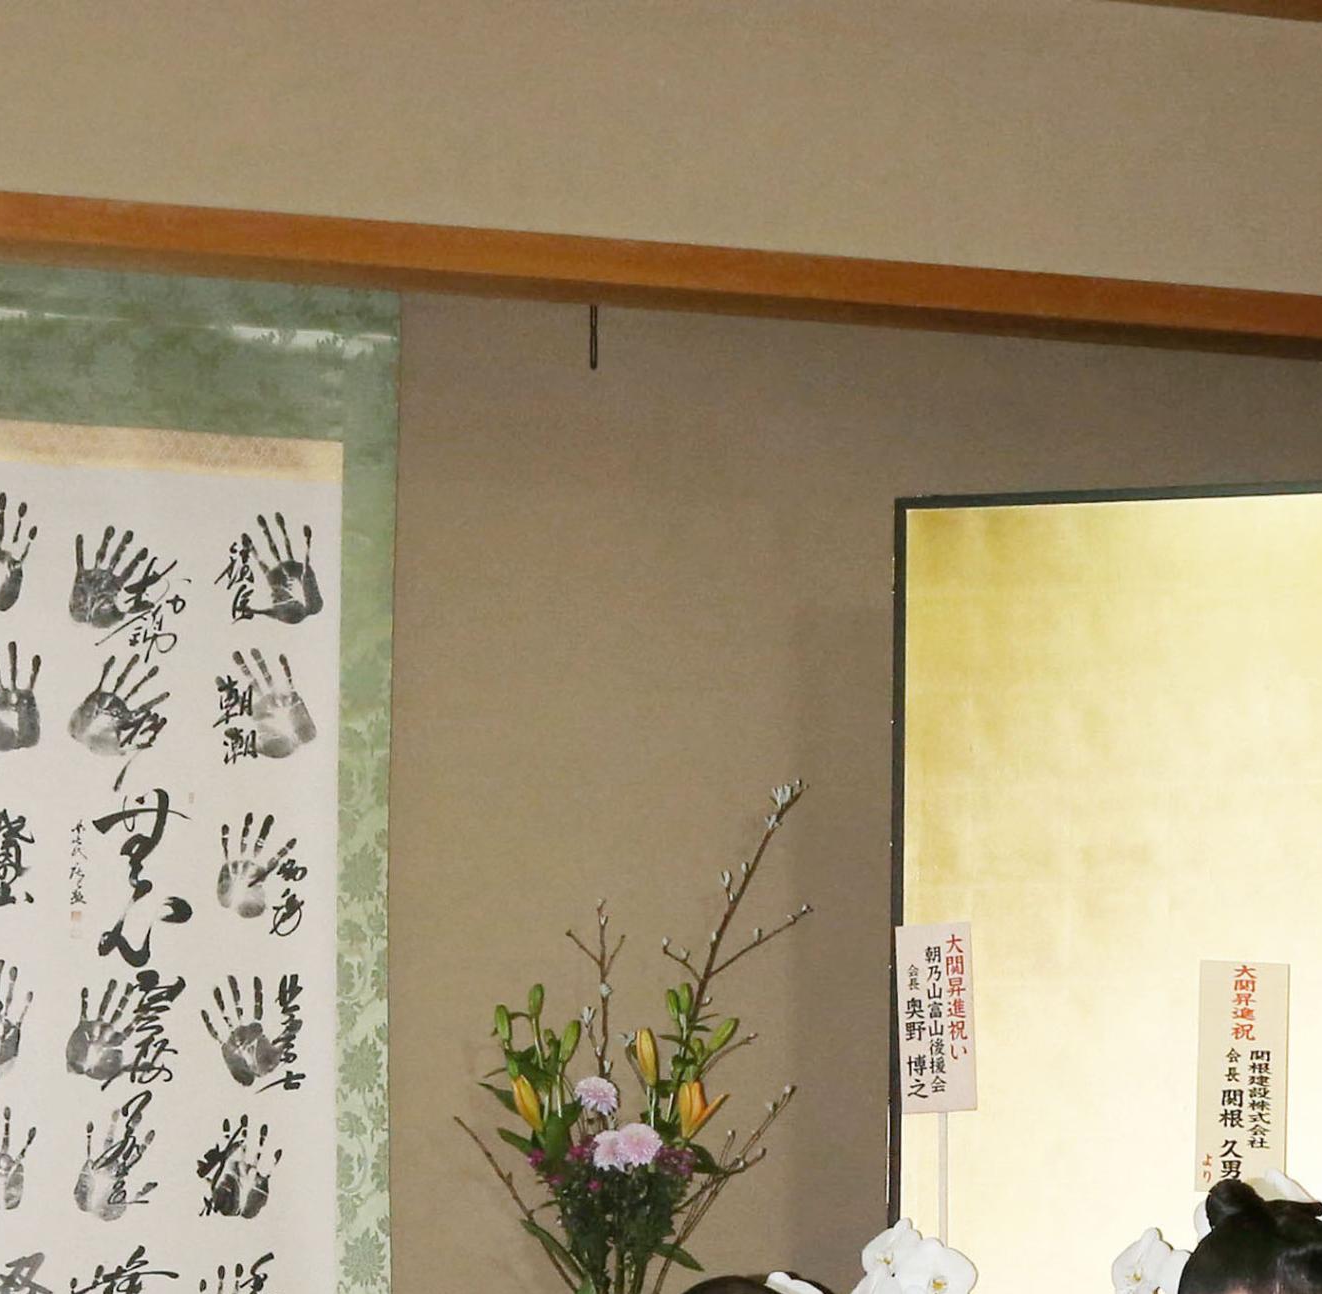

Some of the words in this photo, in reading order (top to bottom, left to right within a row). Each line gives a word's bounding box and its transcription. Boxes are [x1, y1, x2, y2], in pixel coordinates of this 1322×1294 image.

[907, 964, 920, 991] 会長
[945, 934, 968, 1060] 大関昇進祝い
[905, 997, 926, 1041] 奥野
[924, 946, 947, 1093] 朝乃山富山後援会
[1231, 964, 1257, 1041] 大関昇進祝
[906, 1055, 929, 1099] 博之
[1225, 1048, 1241, 1082] 会長
[1219, 1089, 1245, 1129] 関根
[1247, 1050, 1272, 1149] 関根建設株式会社
[1202, 1153, 1213, 1183] より
[1219, 1139, 1244, 1179] 久男
